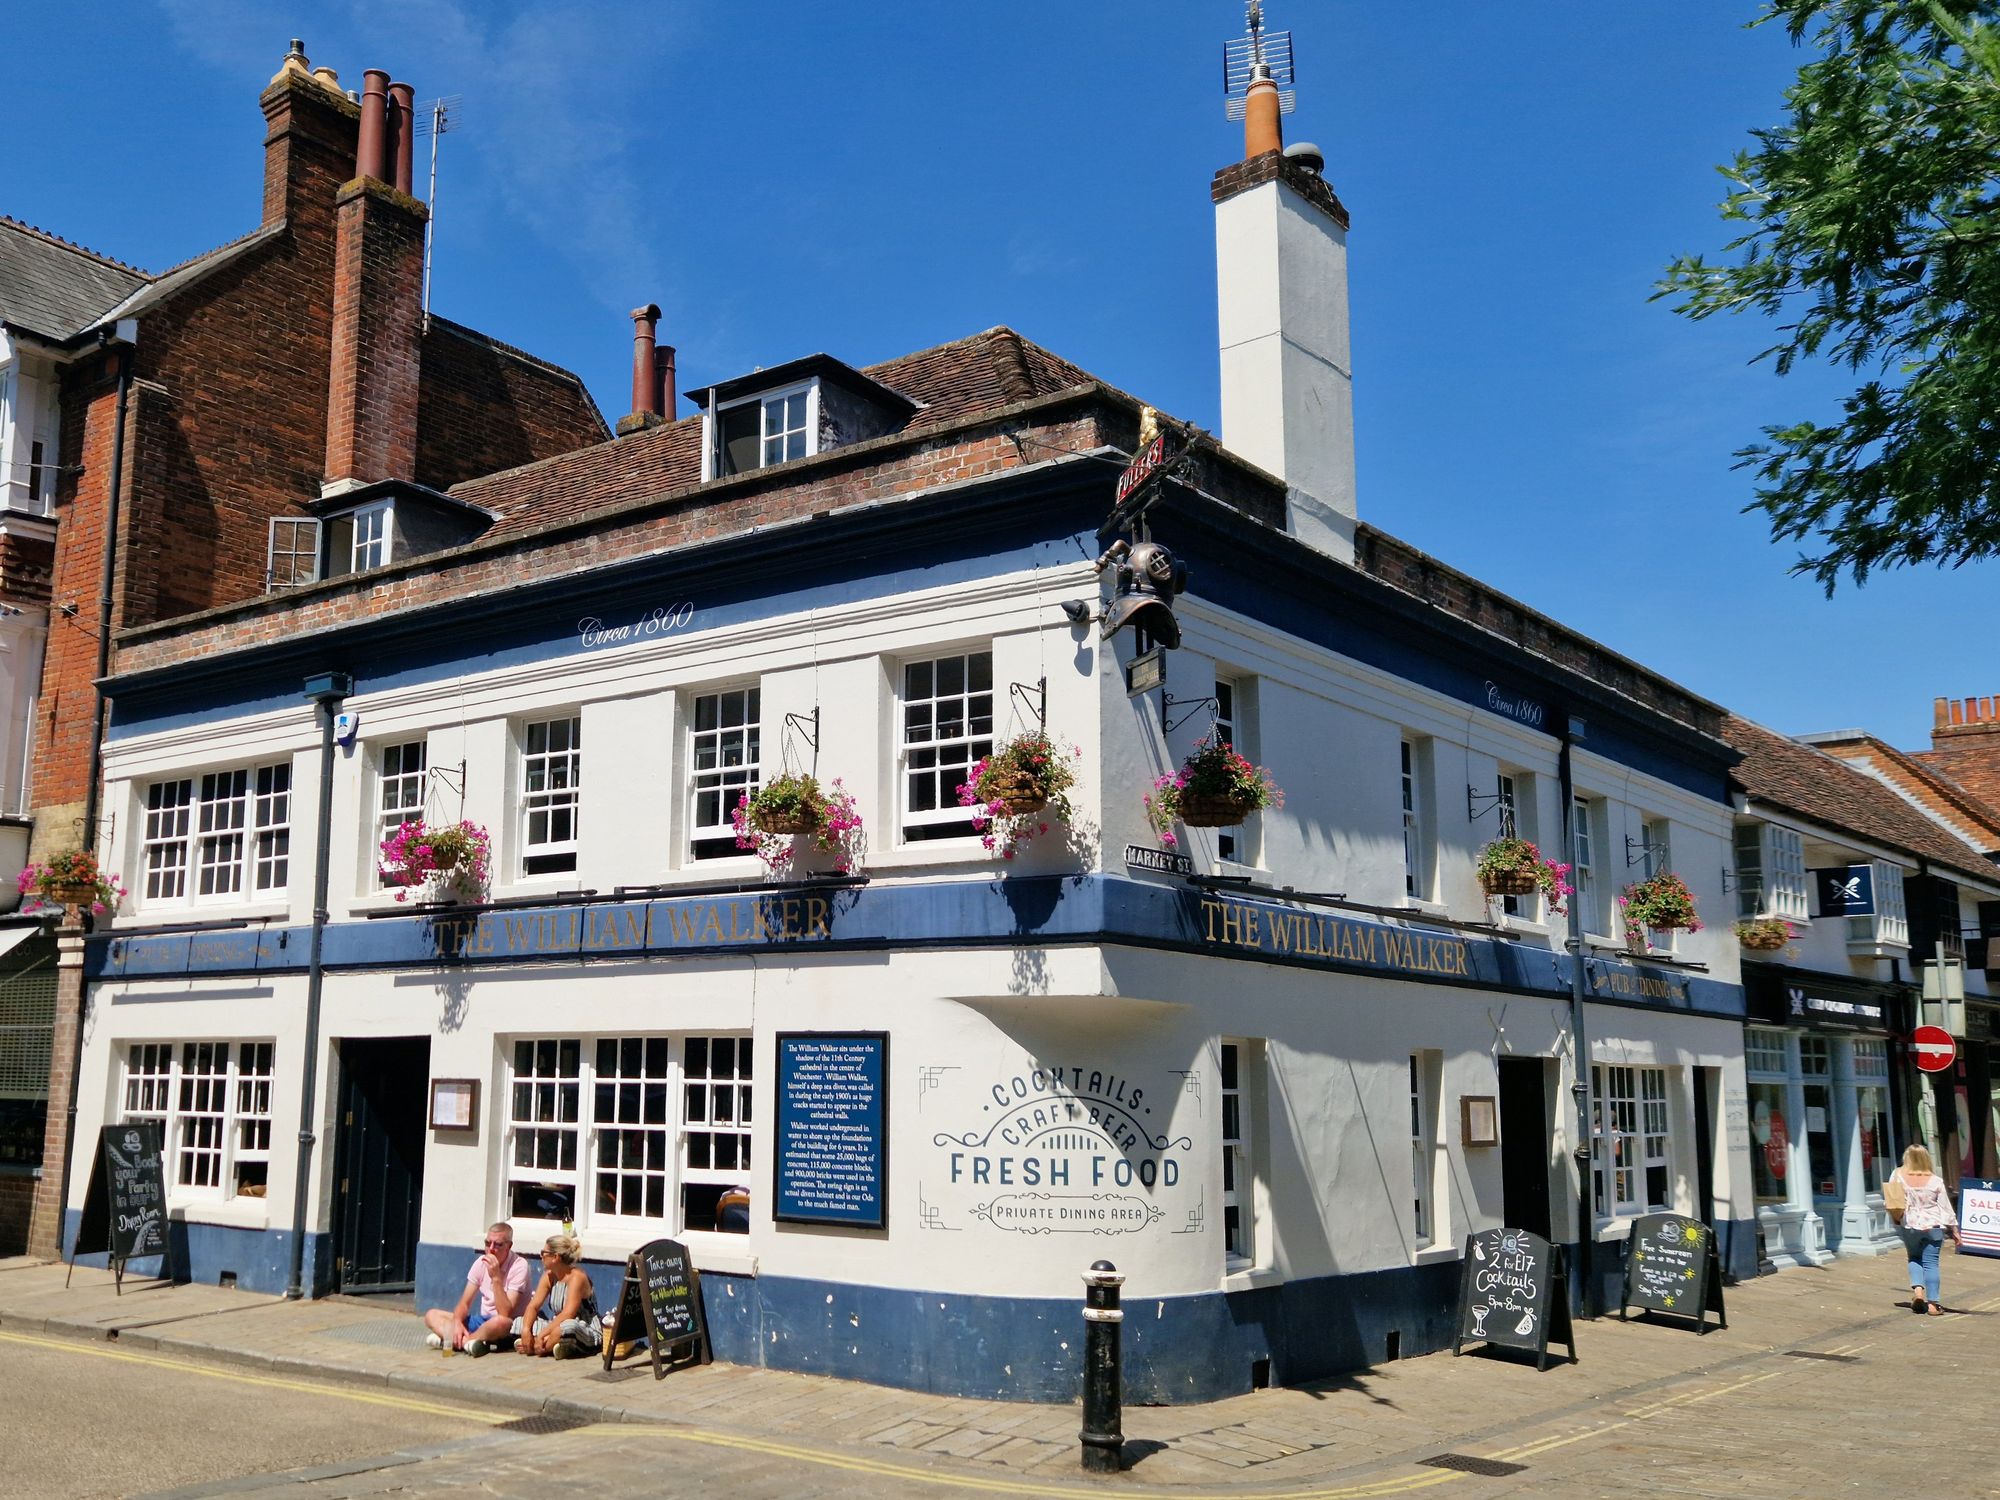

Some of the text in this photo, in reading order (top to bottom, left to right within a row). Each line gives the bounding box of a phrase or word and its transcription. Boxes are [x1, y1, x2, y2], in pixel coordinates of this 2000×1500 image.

[578, 602, 694, 647] Circa 1860
[1485, 681, 1542, 725] Circa 1860
[1128, 848, 1174, 870] MARKET
[433, 898, 831, 954] THE WILLIAM WALKER
[1201, 899, 1468, 975] THE WILLIAM WALKER
[1611, 973, 1630, 993] PUB
[1639, 977, 1671, 999] DINING
[844, 1054, 865, 1063] Century
[811, 1082, 823, 1091] deep
[992, 1067, 1143, 1110] COCKTAILS
[795, 1092, 811, 1100] during
[822, 1093, 834, 1101] early
[859, 1093, 872, 1102] huge
[810, 1122, 828, 1130] worked
[829, 1124, 862, 1133] underground
[1002, 1104, 1136, 1151] CRAFT BEER
[842, 1133, 872, 1141] foundations
[807, 1142, 828, 1151] building
[856, 1154, 867, 1163] bags
[817, 1171, 832, 1179] bricks
[951, 1153, 1179, 1187] FRESH FOOD
[844, 1184, 854, 1192] sign
[862, 1193, 874, 1201] Ode
[997, 1206, 1142, 1220] PRIVATE DINING AREA
[1489, 1252, 1501, 1269] 2
[1476, 1269, 1536, 1299] Cocktails
